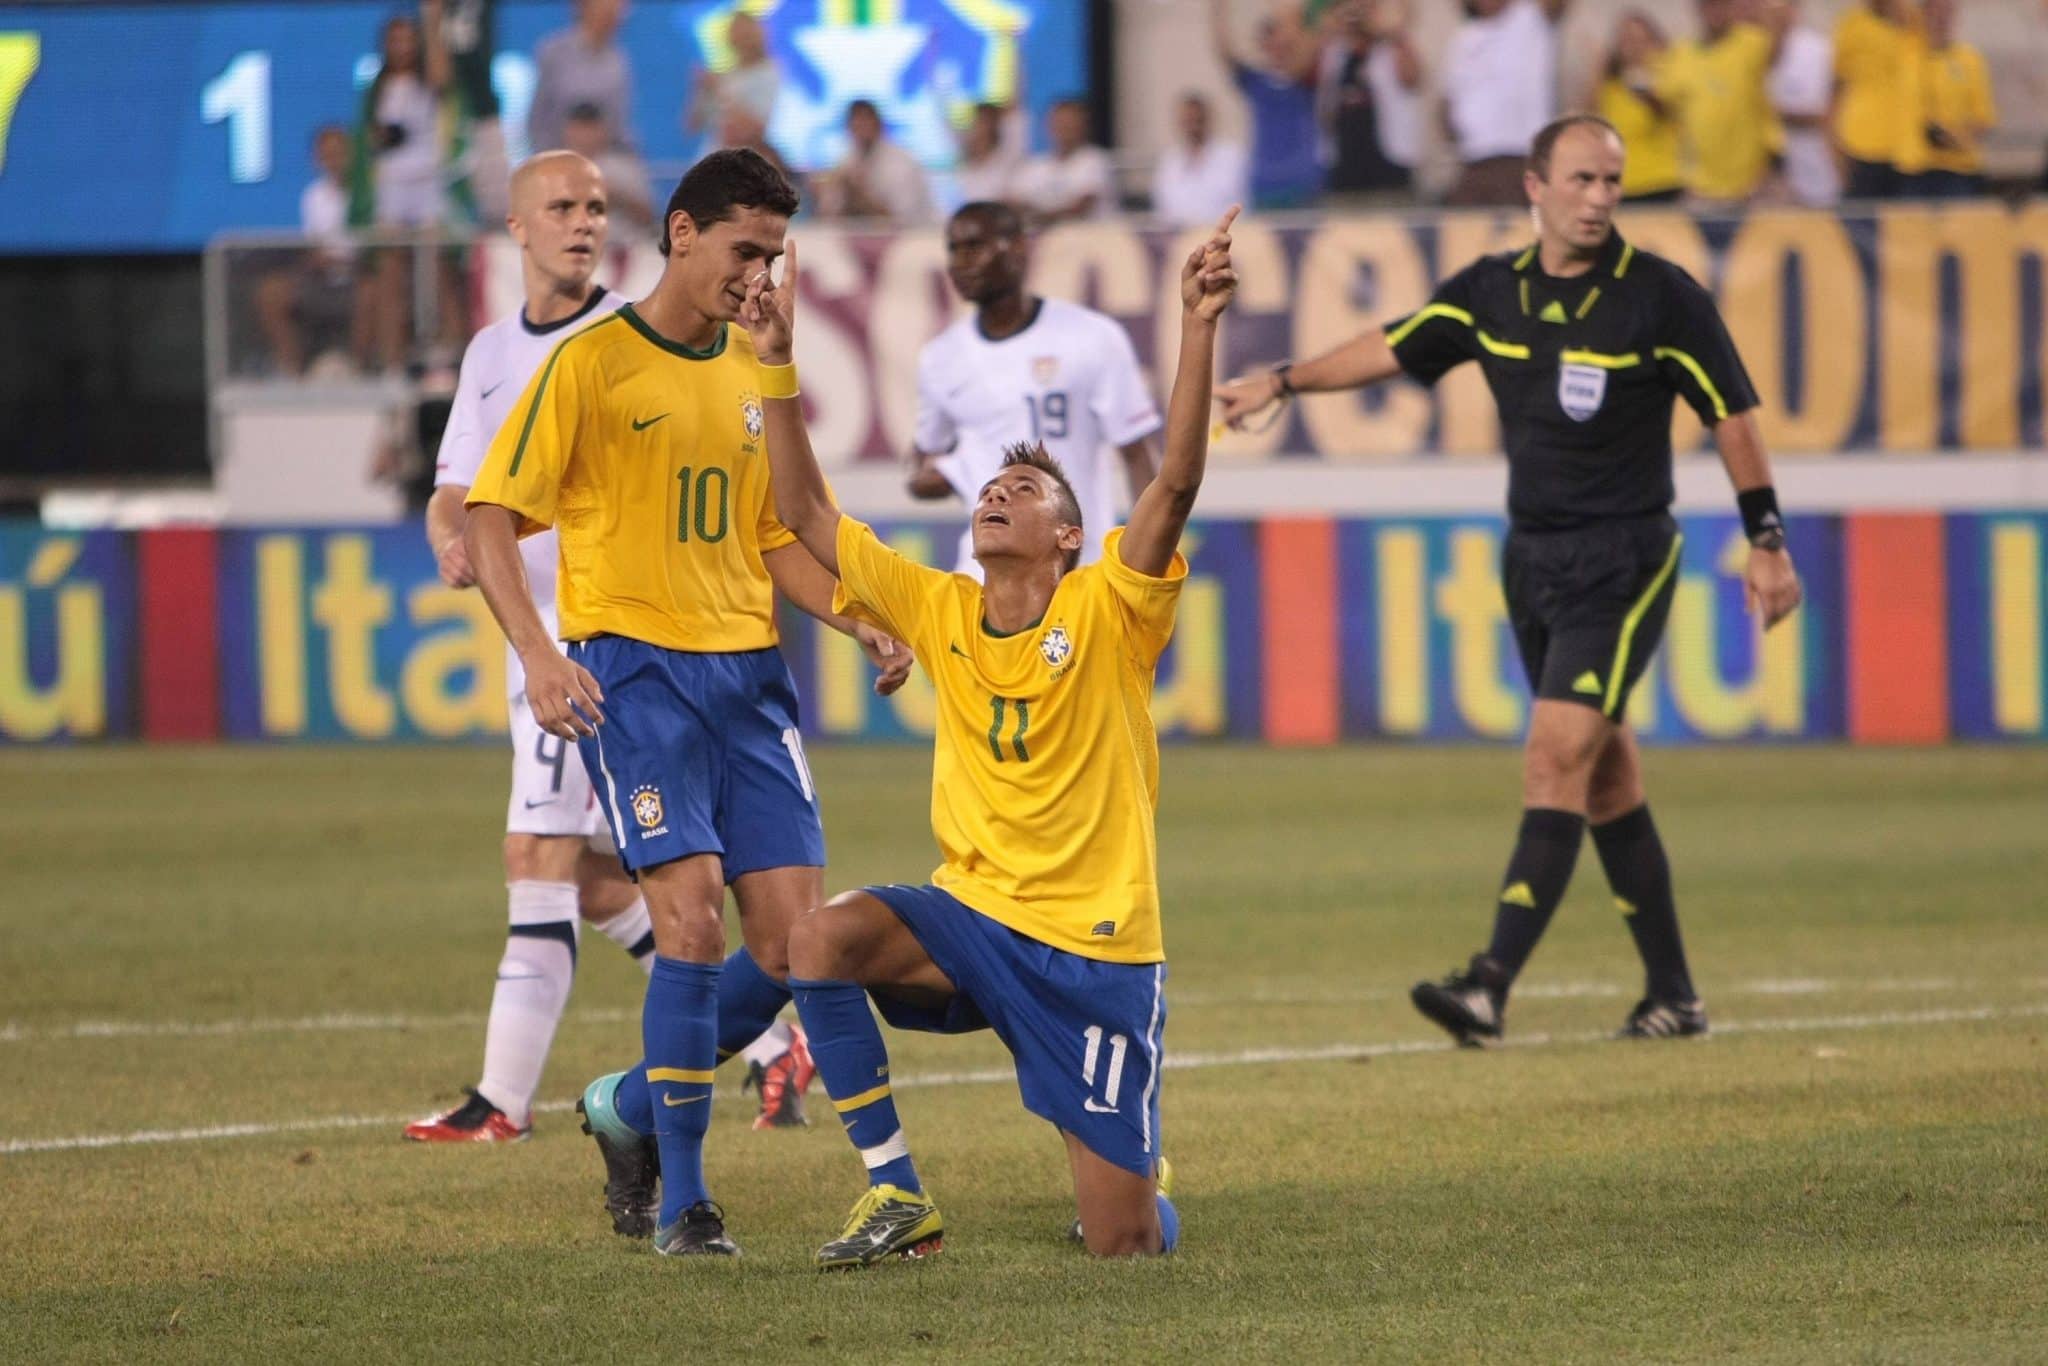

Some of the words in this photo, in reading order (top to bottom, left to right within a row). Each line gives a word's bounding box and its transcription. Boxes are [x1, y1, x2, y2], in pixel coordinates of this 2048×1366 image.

[1023, 391, 1069, 440] 19
[677, 466, 729, 543] 10
[255, 532, 509, 740] Ita
[1376, 526, 1806, 740] Itú
[781, 727, 817, 802] 1
[988, 695, 1030, 763] 11
[641, 825, 669, 840] BRASIL
[1082, 1024, 1128, 1108] 11
